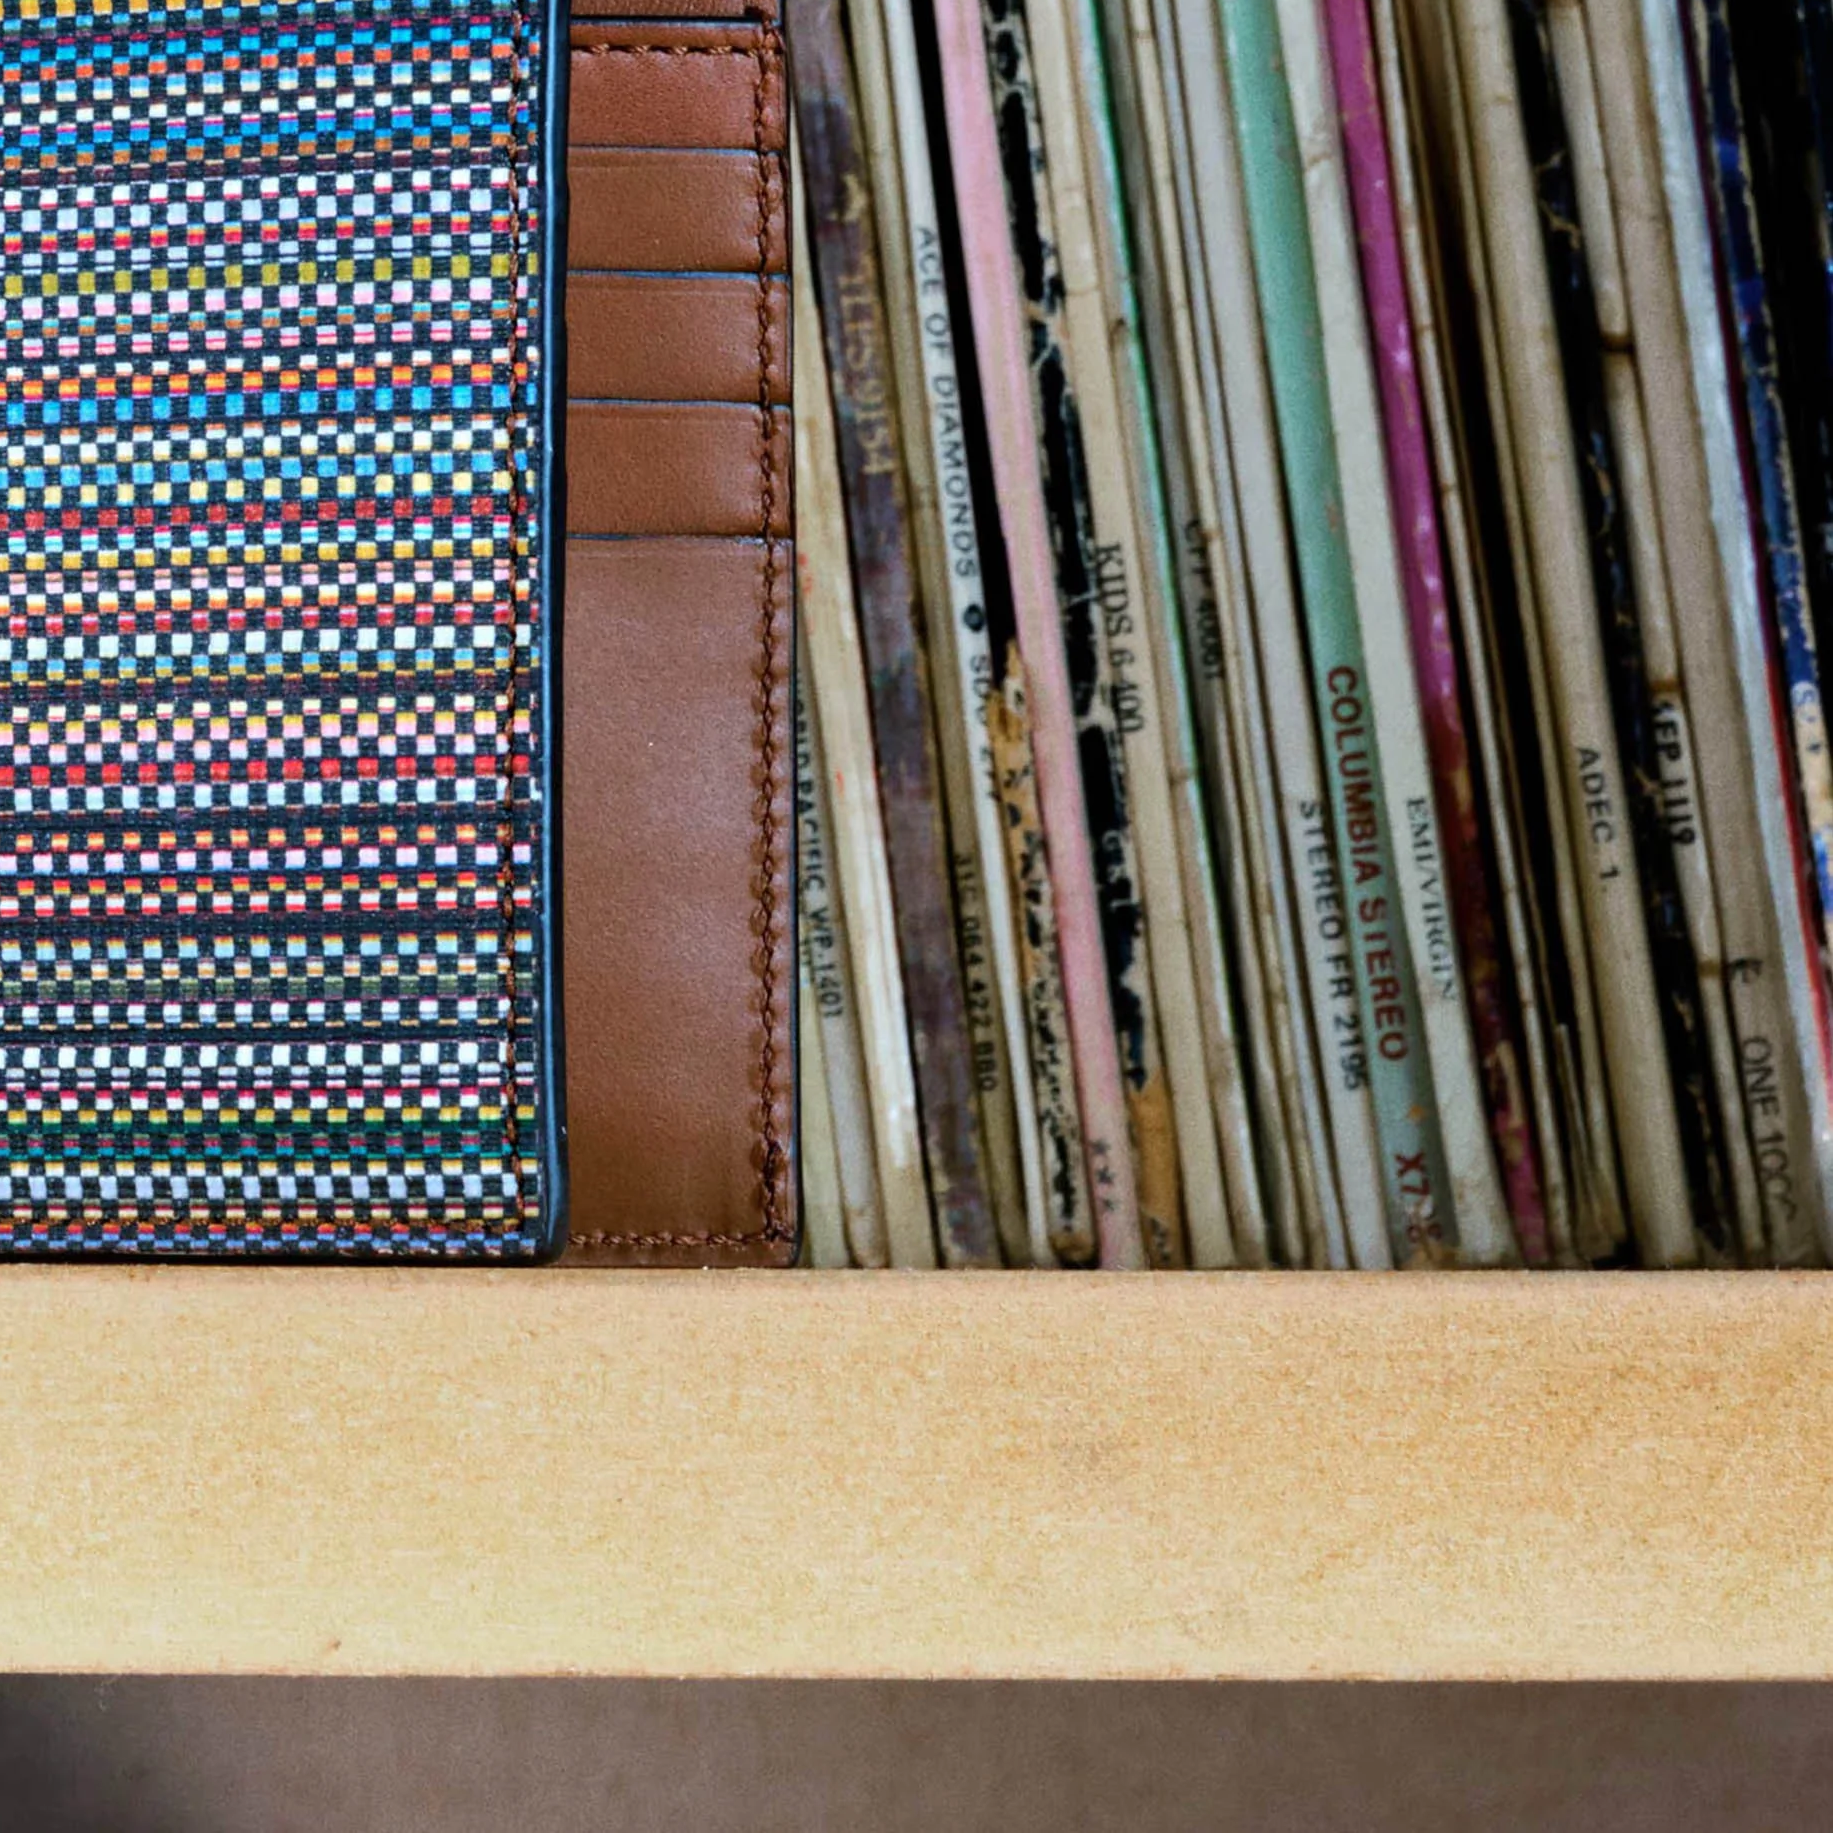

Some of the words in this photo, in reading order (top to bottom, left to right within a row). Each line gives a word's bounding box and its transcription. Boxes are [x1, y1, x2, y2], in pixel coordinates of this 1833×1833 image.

[914, 224, 943, 298] ACE
[925, 311, 950, 357] OF
[849, 376, 896, 476] 9154
[932, 373, 977, 580] DIAMONDS
[1323, 663, 1390, 884] COLUMBIA
[1355, 895, 1417, 1064] STEREO
[1330, 1011, 1369, 1092] 2195
